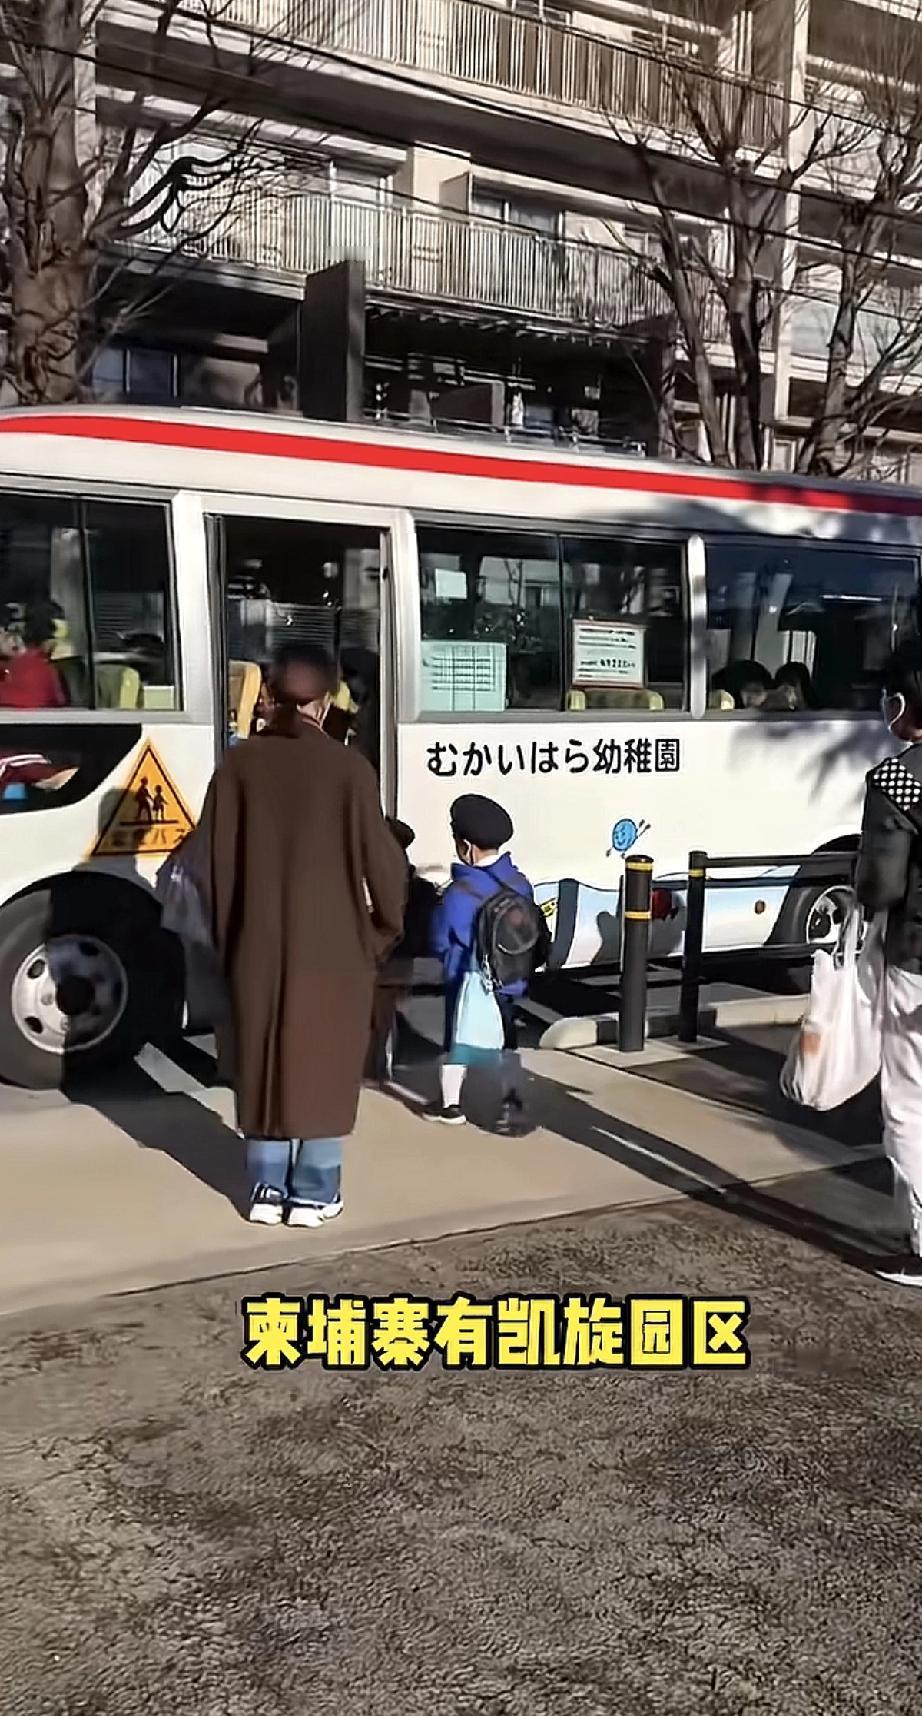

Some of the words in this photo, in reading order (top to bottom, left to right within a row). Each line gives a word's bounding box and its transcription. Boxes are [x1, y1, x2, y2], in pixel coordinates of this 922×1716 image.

[426, 738, 680, 777] むかいはら幼稚園
